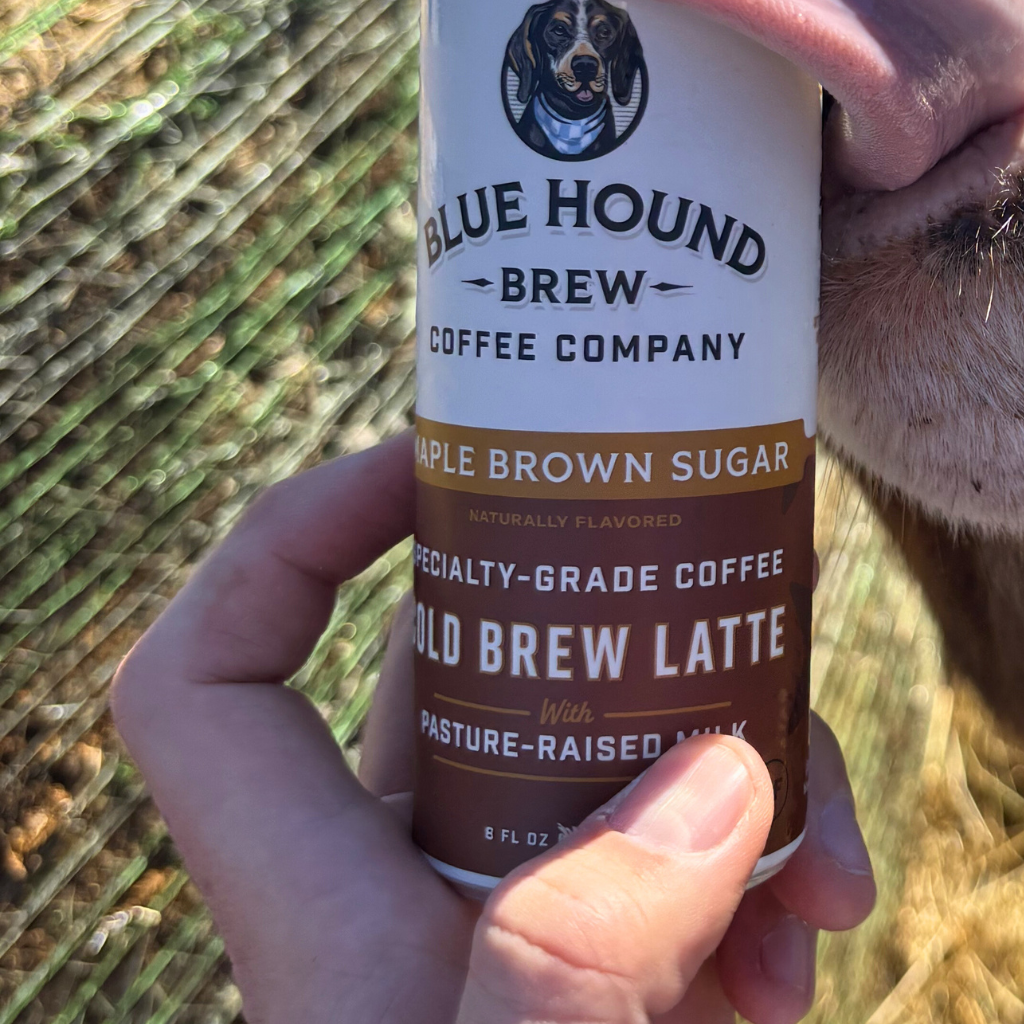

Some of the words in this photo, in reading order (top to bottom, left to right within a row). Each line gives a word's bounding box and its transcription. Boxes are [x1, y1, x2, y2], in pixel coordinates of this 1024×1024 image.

[423, 181, 528, 269] BLUE
[546, 178, 767, 276] HOUND
[500, 267, 647, 305] BREW
[430, 325, 537, 361] COFFEE
[556, 332, 746, 363] COMPANY
[488, 448, 653, 483] BROWN
[671, 441, 790, 482] SUGAR
[469, 509, 568, 528] NATURALLY
[575, 514, 682, 529] FLAVORED
[675, 548, 784, 590] COFFEE
[414, 601, 461, 667] OLD
[479, 618, 630, 681] BREW
[654, 604, 786, 680] LATTE
[539, 698, 595, 725] With
[421, 709, 662, 762] PASTURE-RAISED
[484, 826, 494, 841] 8
[501, 829, 519, 844] FL
[527, 832, 549, 847] OZ
